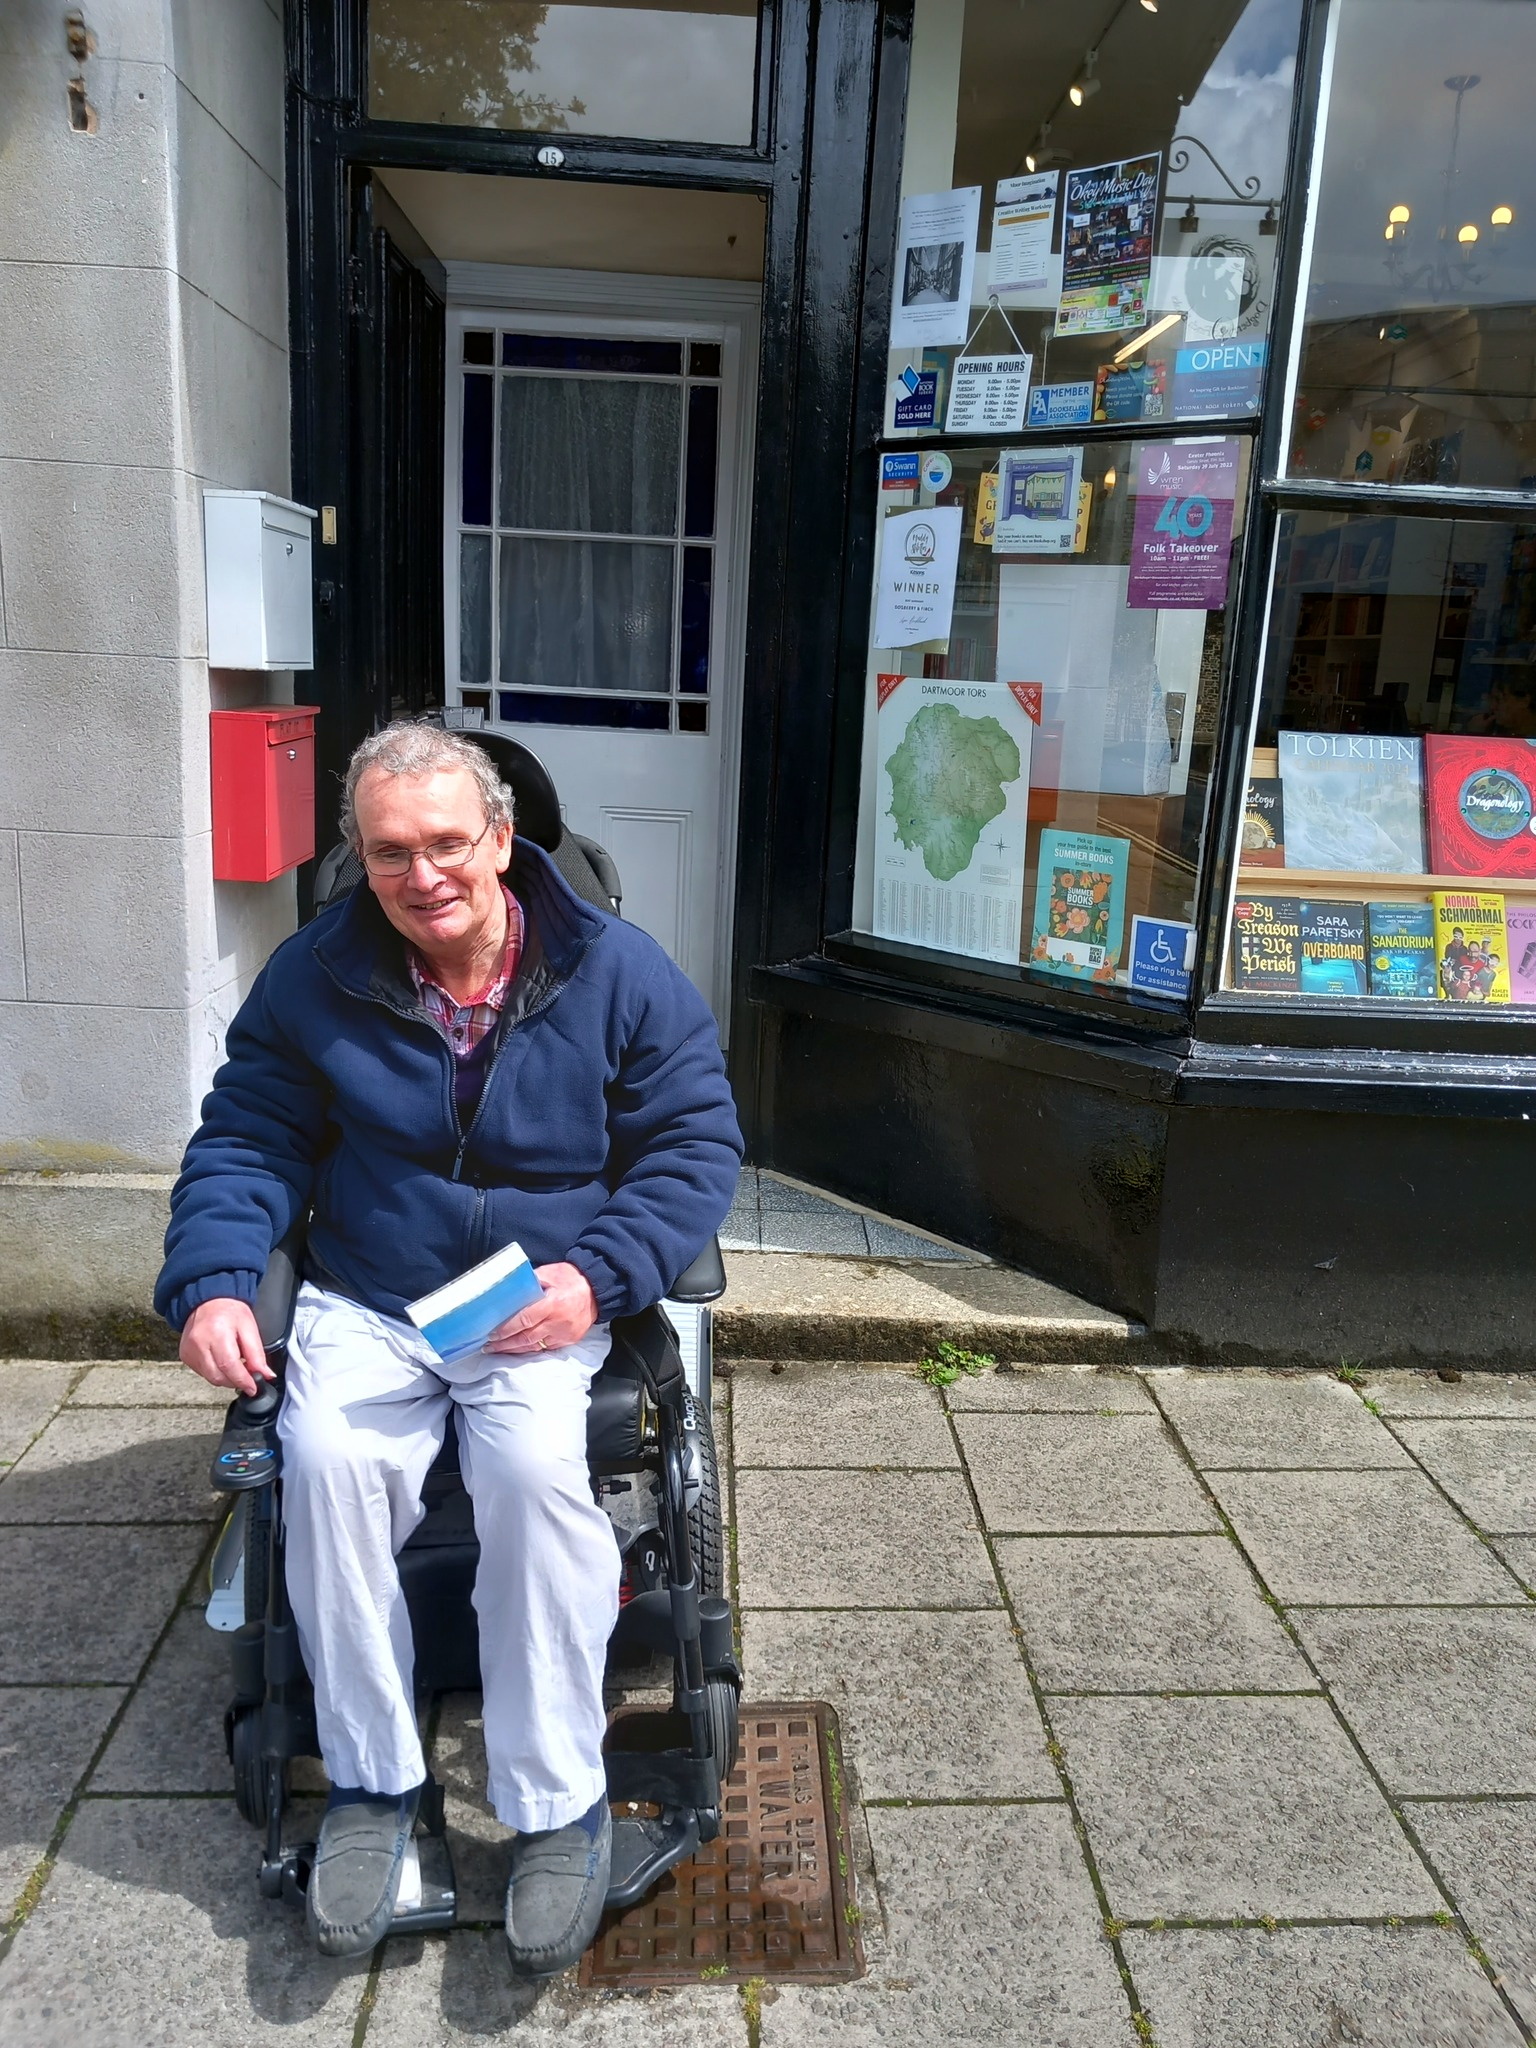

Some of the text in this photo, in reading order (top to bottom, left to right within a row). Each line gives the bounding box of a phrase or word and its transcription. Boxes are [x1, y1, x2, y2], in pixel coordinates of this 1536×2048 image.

[545, 151, 557, 165] 15
[1070, 180, 1100, 202] Okey
[1101, 177, 1133, 197] Music
[1133, 172, 1156, 201] Day
[998, 208, 1014, 216] Creative
[1014, 206, 1030, 214] Writing
[1192, 346, 1252, 370] OPEN
[958, 361, 1026, 374] OPENING HOURS
[1050, 386, 1090, 398] MEMBER
[1050, 405, 1089, 413] BOOKSELLERS
[894, 461, 916, 471] Swann
[1160, 476, 1183, 484] wren
[1154, 494, 1214, 539] 40
[1144, 544, 1219, 553] Folk Takeover
[894, 582, 940, 594] WINNER
[878, 677, 898, 704] DISPLAY ONLY
[880, 679, 888, 690] FOR
[922, 686, 987, 698] DARTMOOR TORS
[1027, 687, 1037, 699] FOR
[1014, 686, 1039, 716] DISPLAY ONLY
[1286, 734, 1416, 761] TOLKIEN
[1295, 758, 1410, 776] CALENDAR 2024
[1466, 795, 1525, 813] Dragonology
[1054, 848, 1114, 865] SUMMER BOOKS
[1068, 887, 1094, 896] SUMMER
[1067, 894, 1094, 906] BOOKS
[1445, 896, 1479, 908] NORMAL
[1249, 902, 1273, 922] By
[1440, 908, 1504, 924] SCHMORMAL
[1238, 918, 1299, 937] Treason
[1316, 916, 1349, 927] SARA
[1302, 927, 1364, 939] PARETSKY
[1262, 937, 1293, 954] We
[1372, 936, 1434, 949] SANATORIUM
[1303, 942, 1364, 960] OVERBOARD
[1089, 955, 1101, 964] BAG
[1241, 954, 1296, 975] Perish
[1136, 961, 1190, 978] Please ring bell
[1148, 978, 1187, 990] assistance
[790, 1743, 813, 1806] THOMAS
[759, 1779, 793, 1881] WATER
